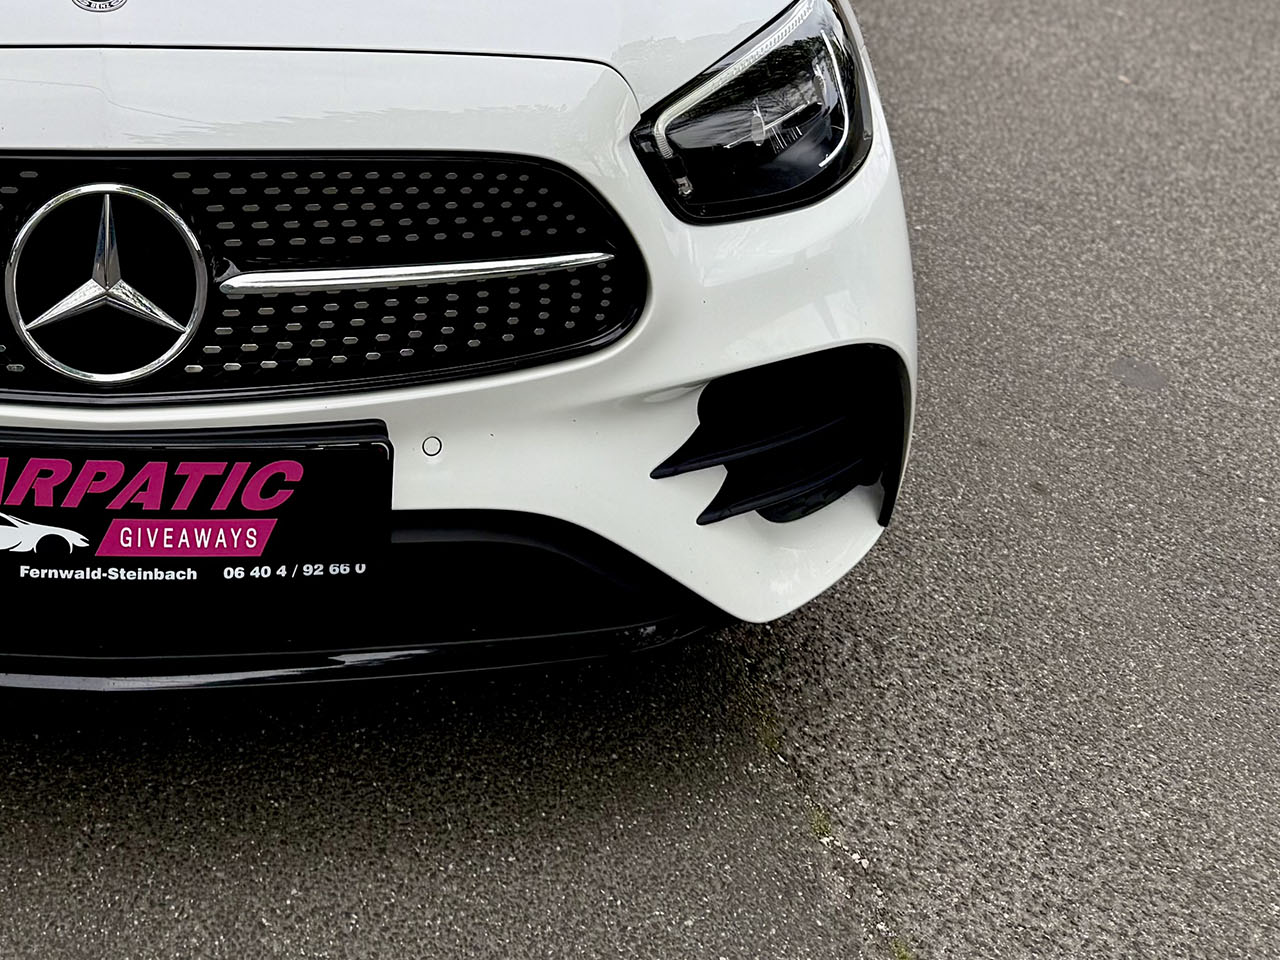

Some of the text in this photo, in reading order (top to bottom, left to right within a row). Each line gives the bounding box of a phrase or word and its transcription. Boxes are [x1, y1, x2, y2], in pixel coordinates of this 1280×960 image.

[119, 526, 258, 549] GIVEAWAYS
[19, 565, 198, 581] Fernwald-Steinbach
[223, 566, 246, 580] 06
[249, 565, 272, 579] 40
[275, 564, 288, 578] 4
[291, 563, 299, 579] /
[302, 563, 325, 577] 92
[328, 563, 351, 575] 66
